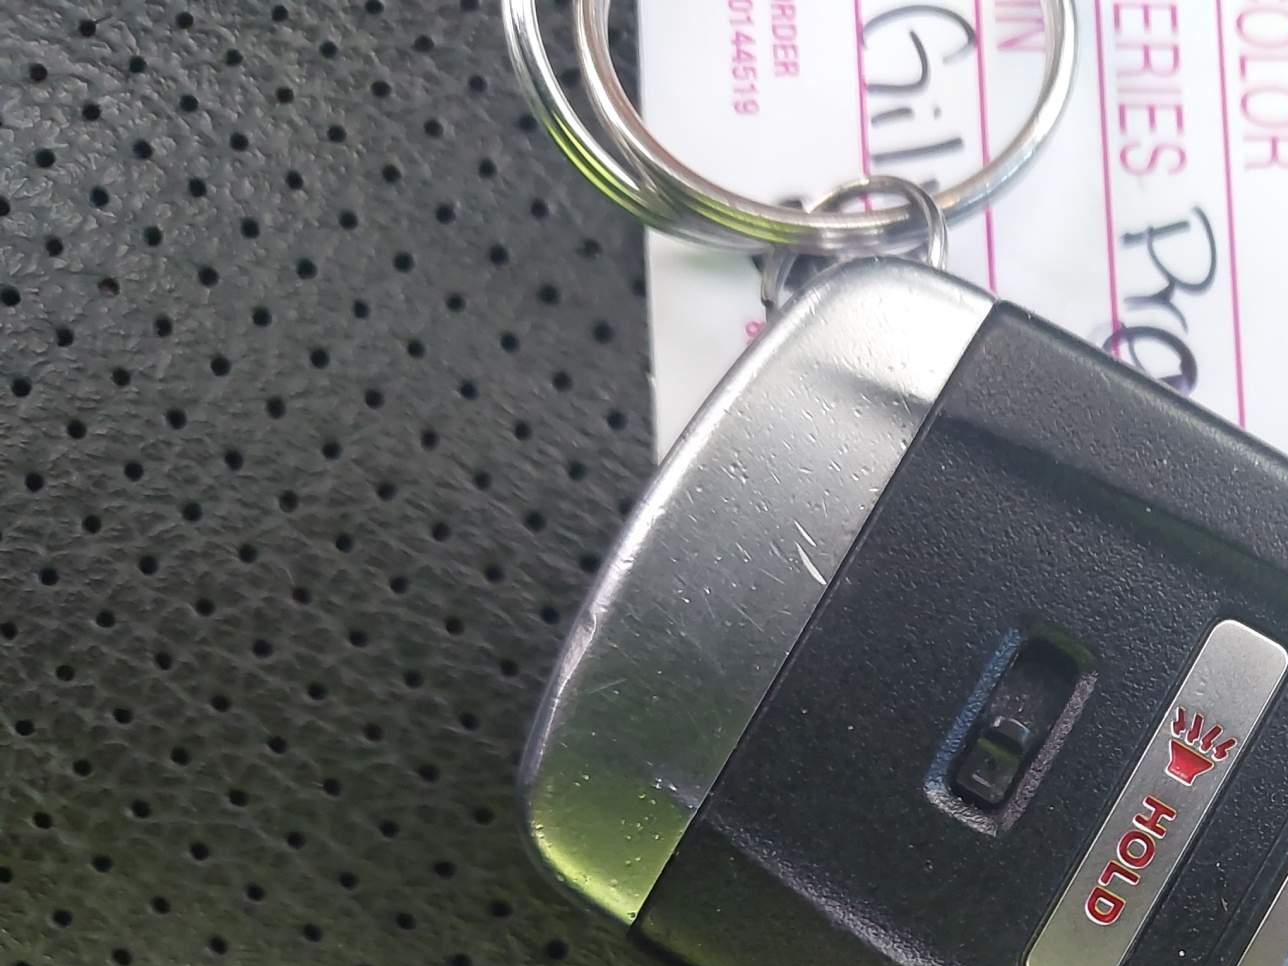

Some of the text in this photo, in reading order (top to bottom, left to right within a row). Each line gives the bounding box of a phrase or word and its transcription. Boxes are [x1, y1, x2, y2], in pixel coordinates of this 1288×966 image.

[770, 0, 801, 78] RDER
[995, 0, 1048, 53] IN
[1113, 0, 1189, 178] ERIES
[860, 3, 978, 195] Gil
[1085, 795, 1177, 926] HOLD
